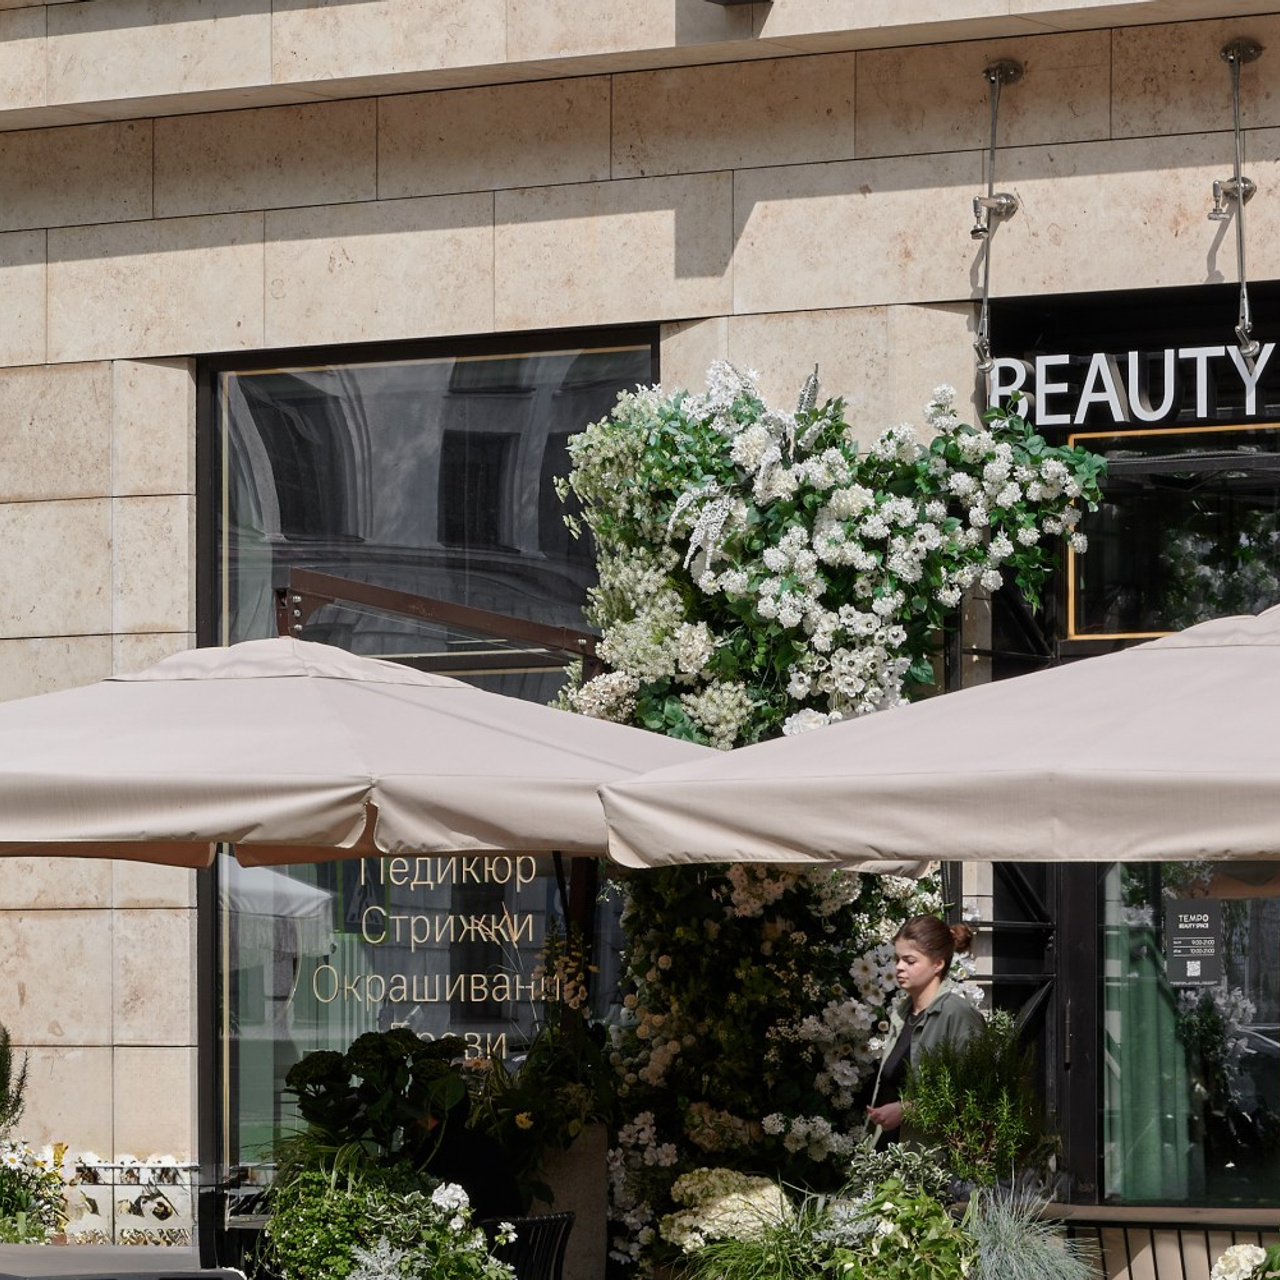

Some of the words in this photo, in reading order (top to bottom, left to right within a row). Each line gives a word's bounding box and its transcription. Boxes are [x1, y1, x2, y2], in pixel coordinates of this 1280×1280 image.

[988, 342, 1276, 427] BEAUTY
[361, 855, 537, 893] Педикюр
[361, 905, 533, 953] Стрижки
[1178, 913, 1209, 923] TEMPO
[312, 964, 560, 1011] Окрашивани
